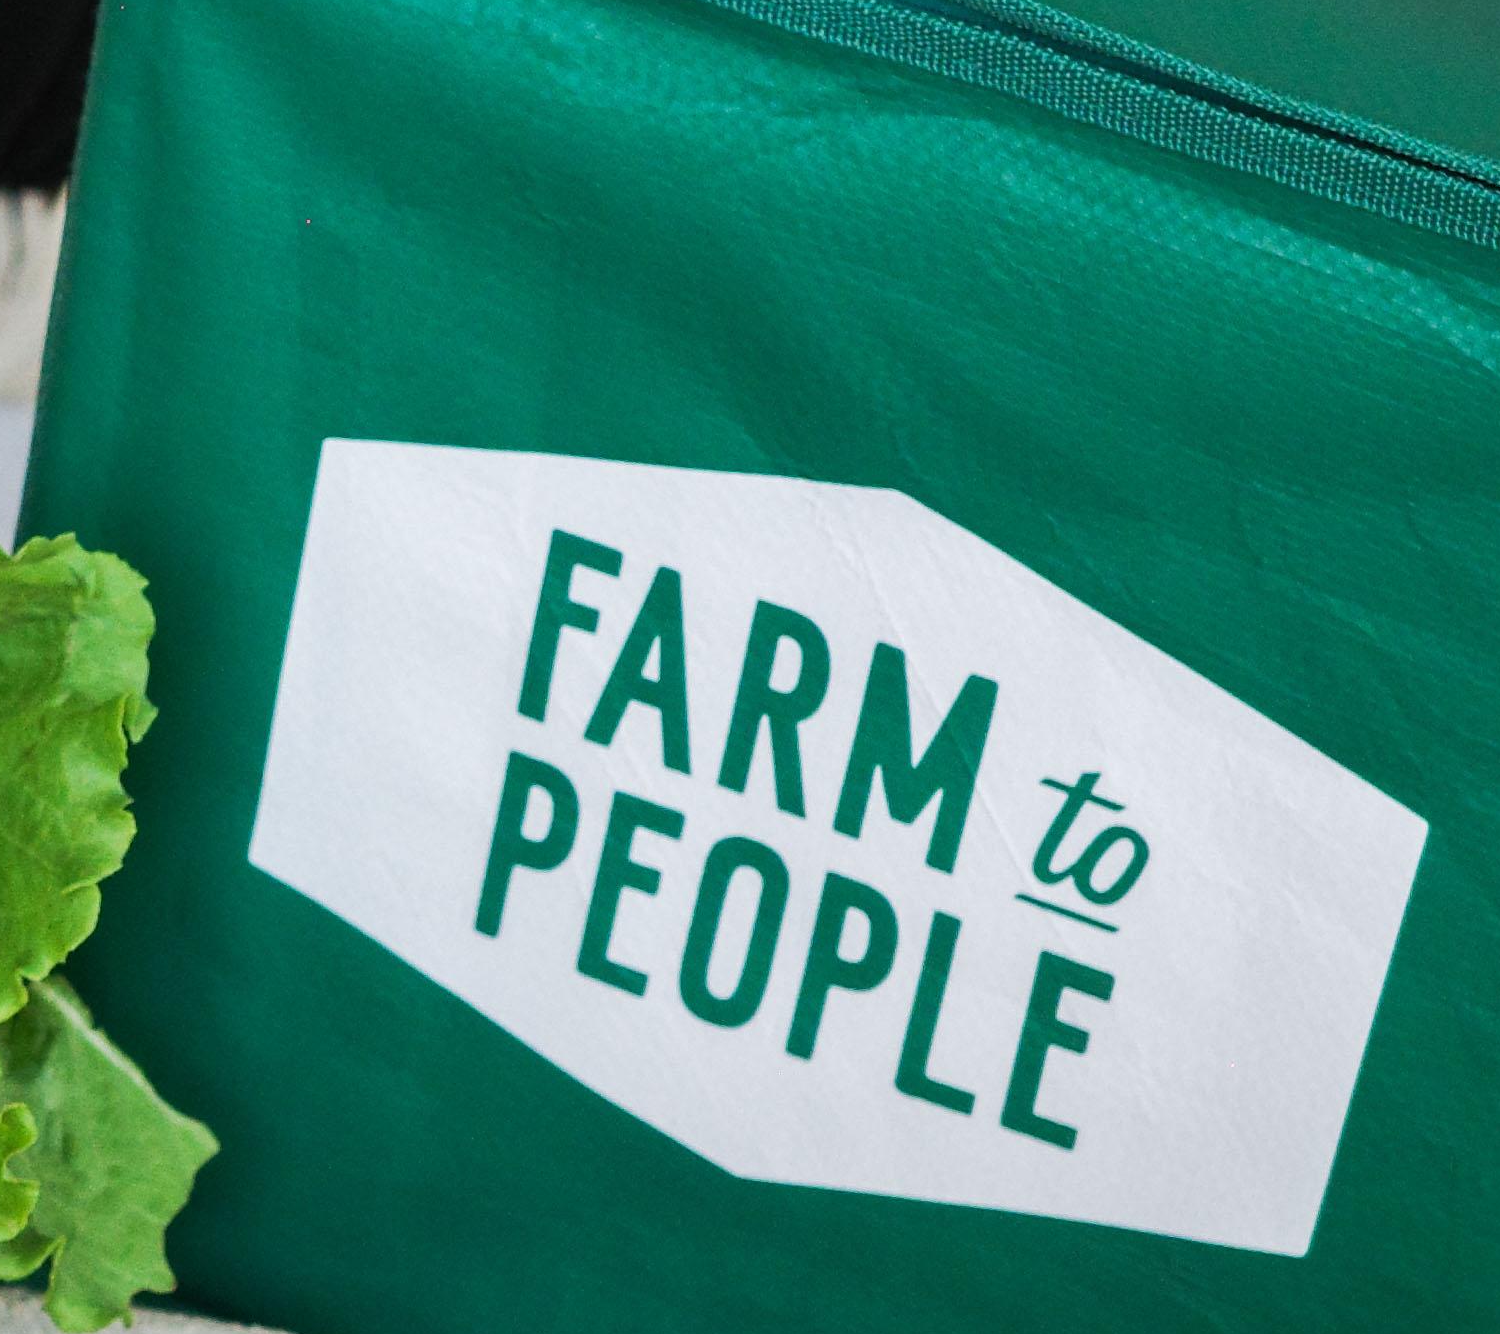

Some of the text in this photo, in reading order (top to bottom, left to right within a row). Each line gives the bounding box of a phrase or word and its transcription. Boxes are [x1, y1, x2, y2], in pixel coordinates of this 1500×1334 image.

[516, 527, 1151, 910] FARM to
[473, 749, 1116, 1152] PEOPLE
